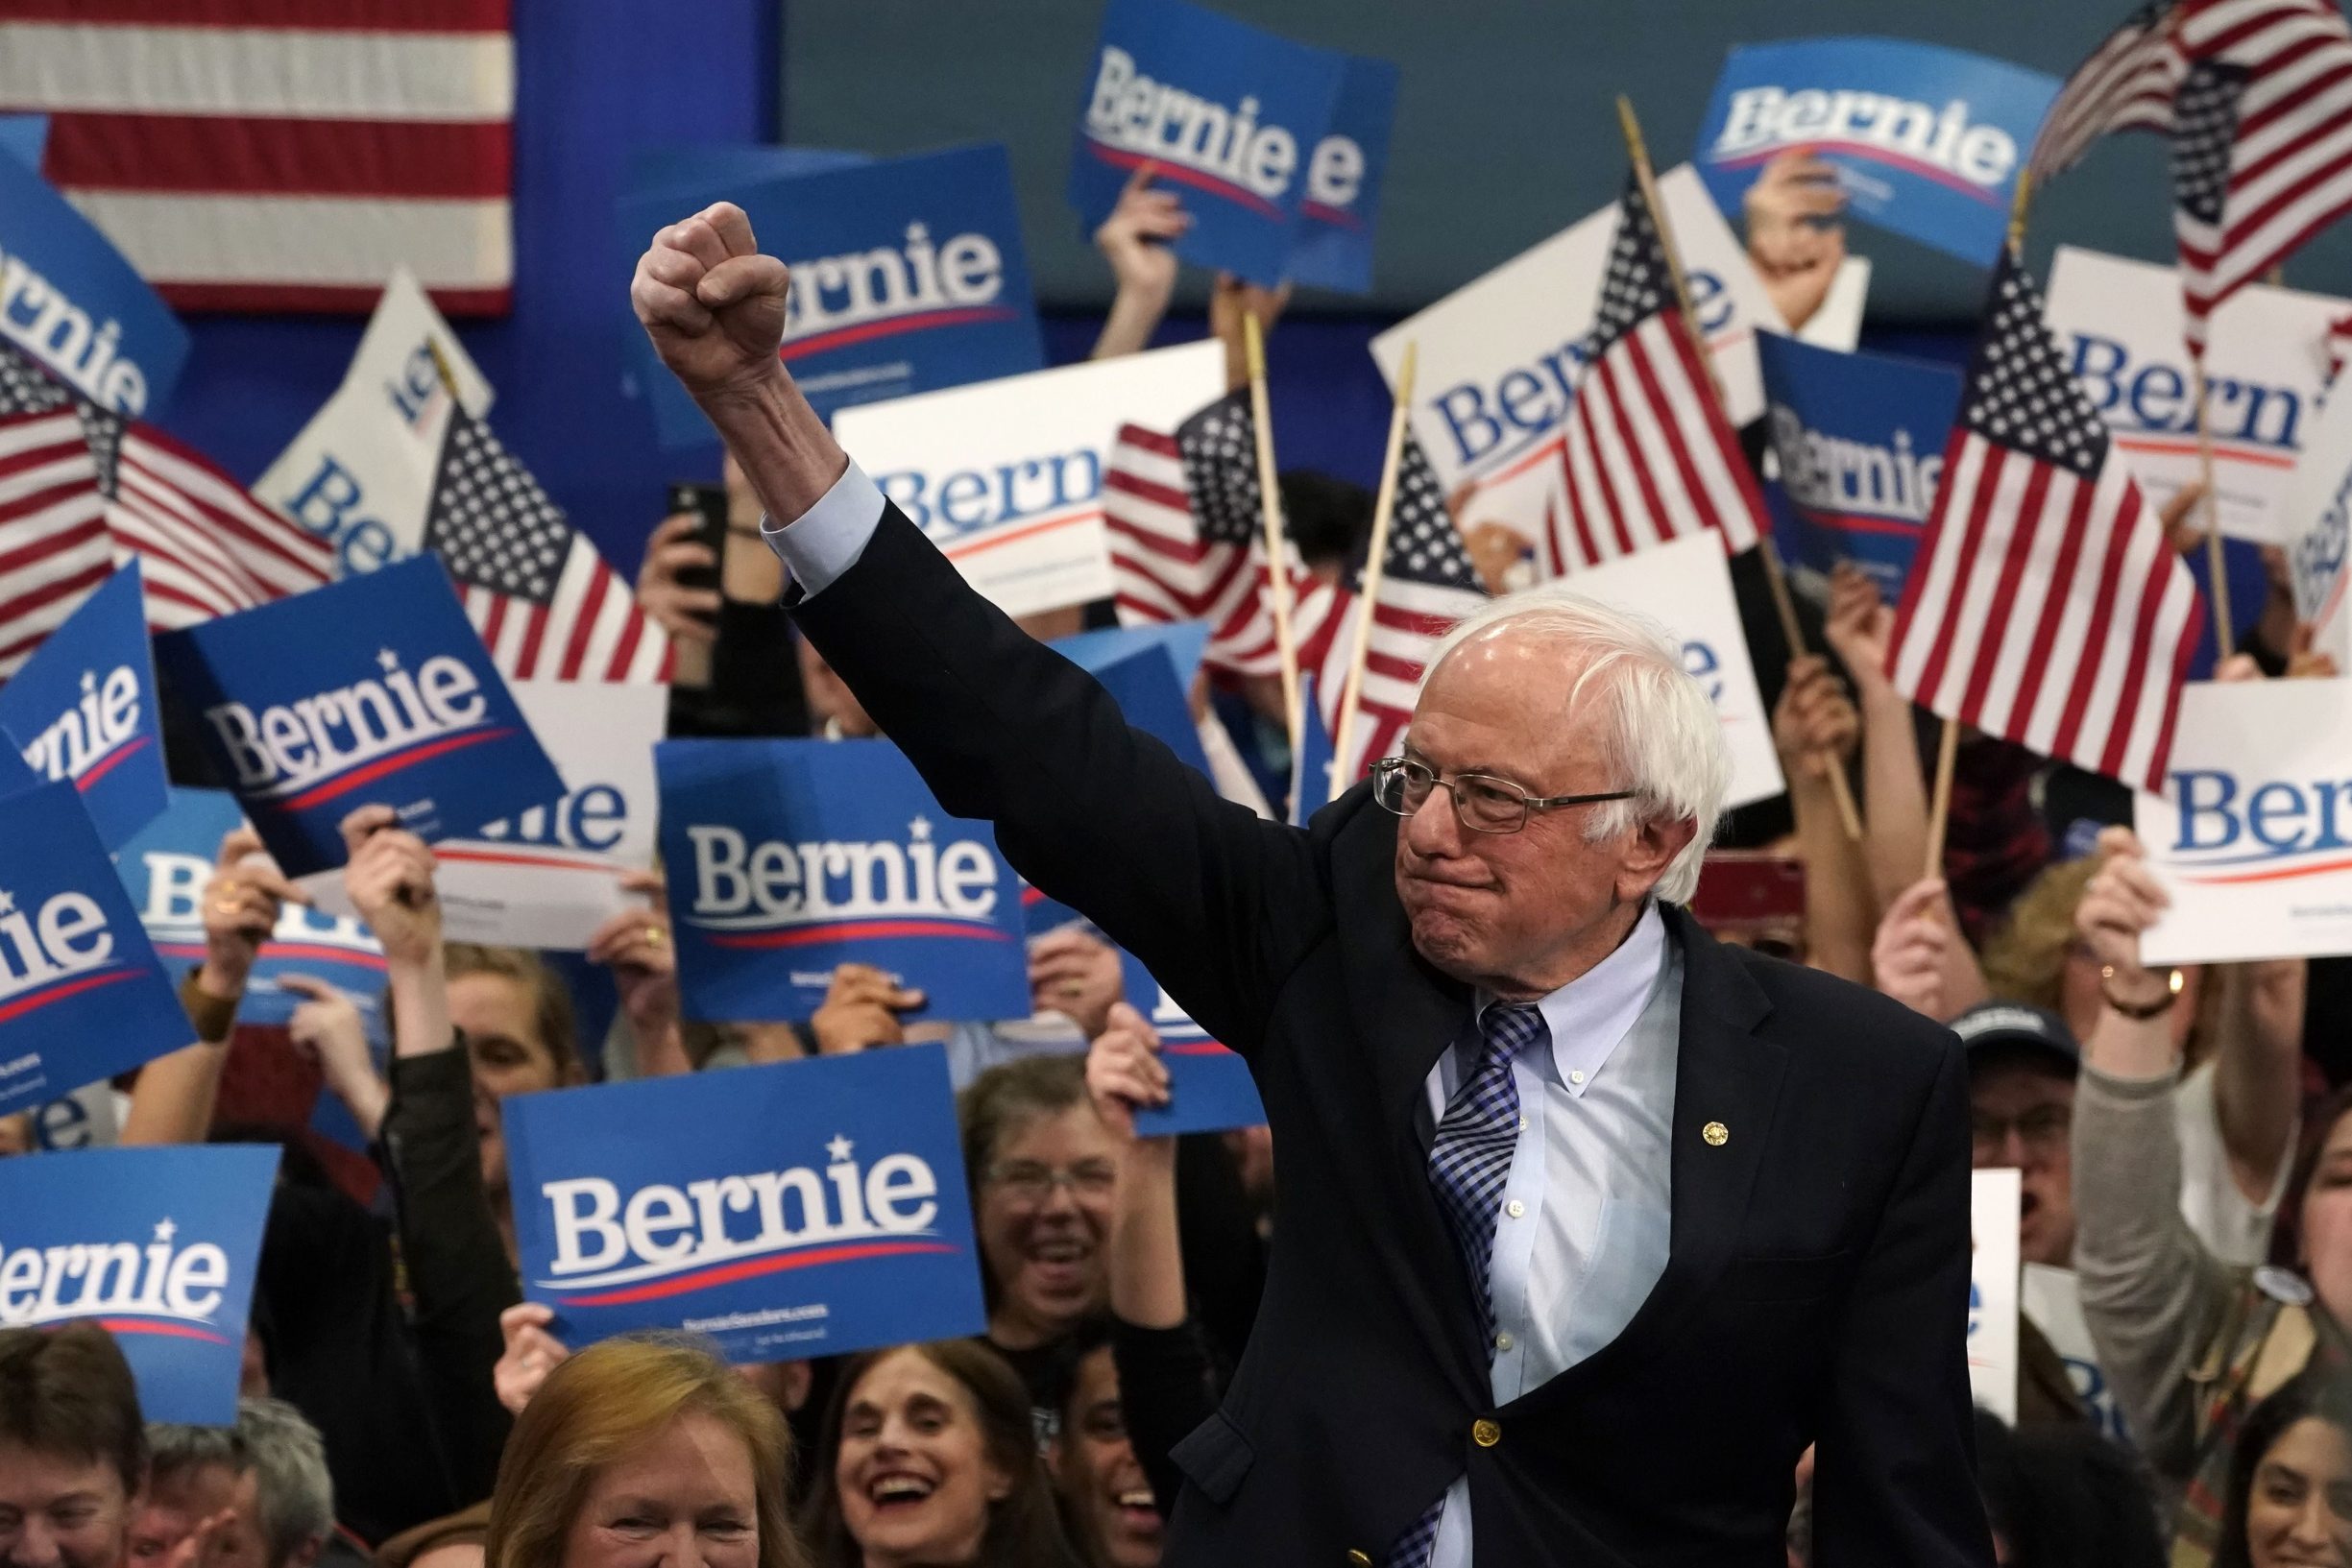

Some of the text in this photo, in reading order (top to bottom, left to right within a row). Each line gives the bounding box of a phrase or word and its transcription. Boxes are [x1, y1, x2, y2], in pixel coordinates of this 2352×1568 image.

[1085, 45, 1297, 198] Bernie
[1715, 86, 2016, 184] Bernie
[785, 222, 1002, 336] rnie
[206, 647, 487, 786] Bernie
[687, 814, 998, 917] Bernie
[543, 1134, 938, 1276] Bernie
[0, 1216, 230, 1327] ernie
